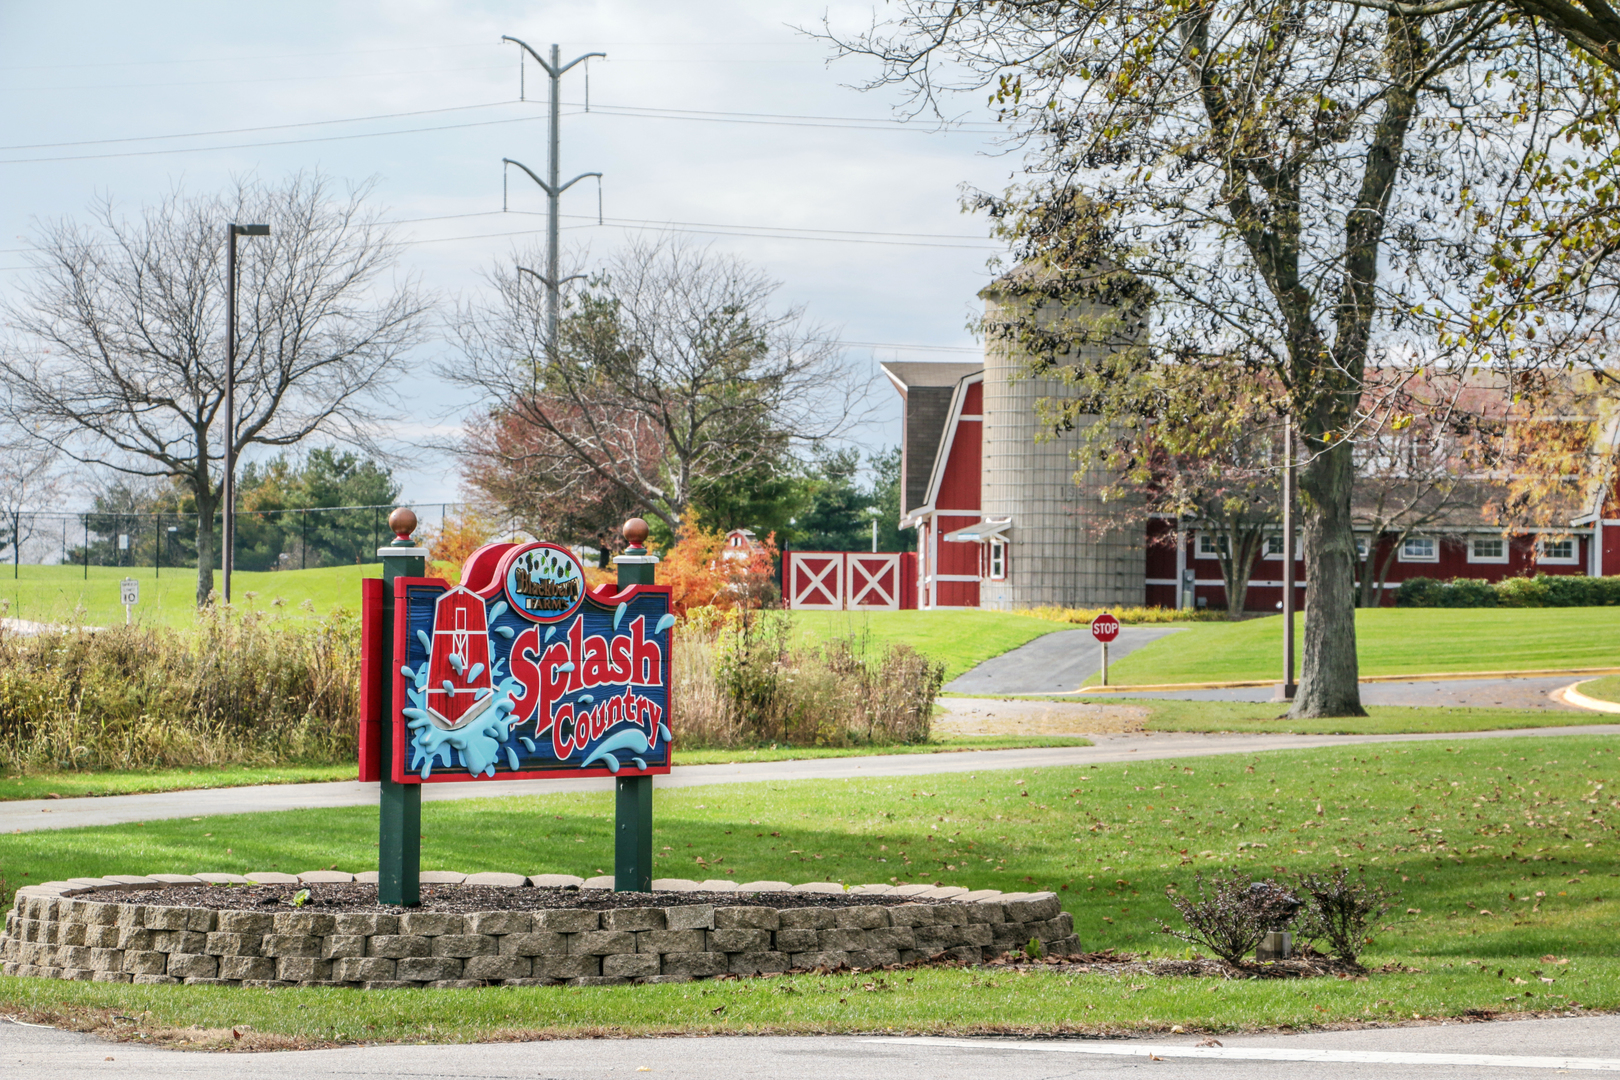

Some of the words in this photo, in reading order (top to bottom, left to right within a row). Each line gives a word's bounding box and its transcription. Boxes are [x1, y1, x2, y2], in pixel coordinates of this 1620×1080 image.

[124, 593, 136, 602] 10
[1093, 622, 1118, 634] STOP
[507, 613, 663, 739] Splash
[552, 685, 662, 760] Country
